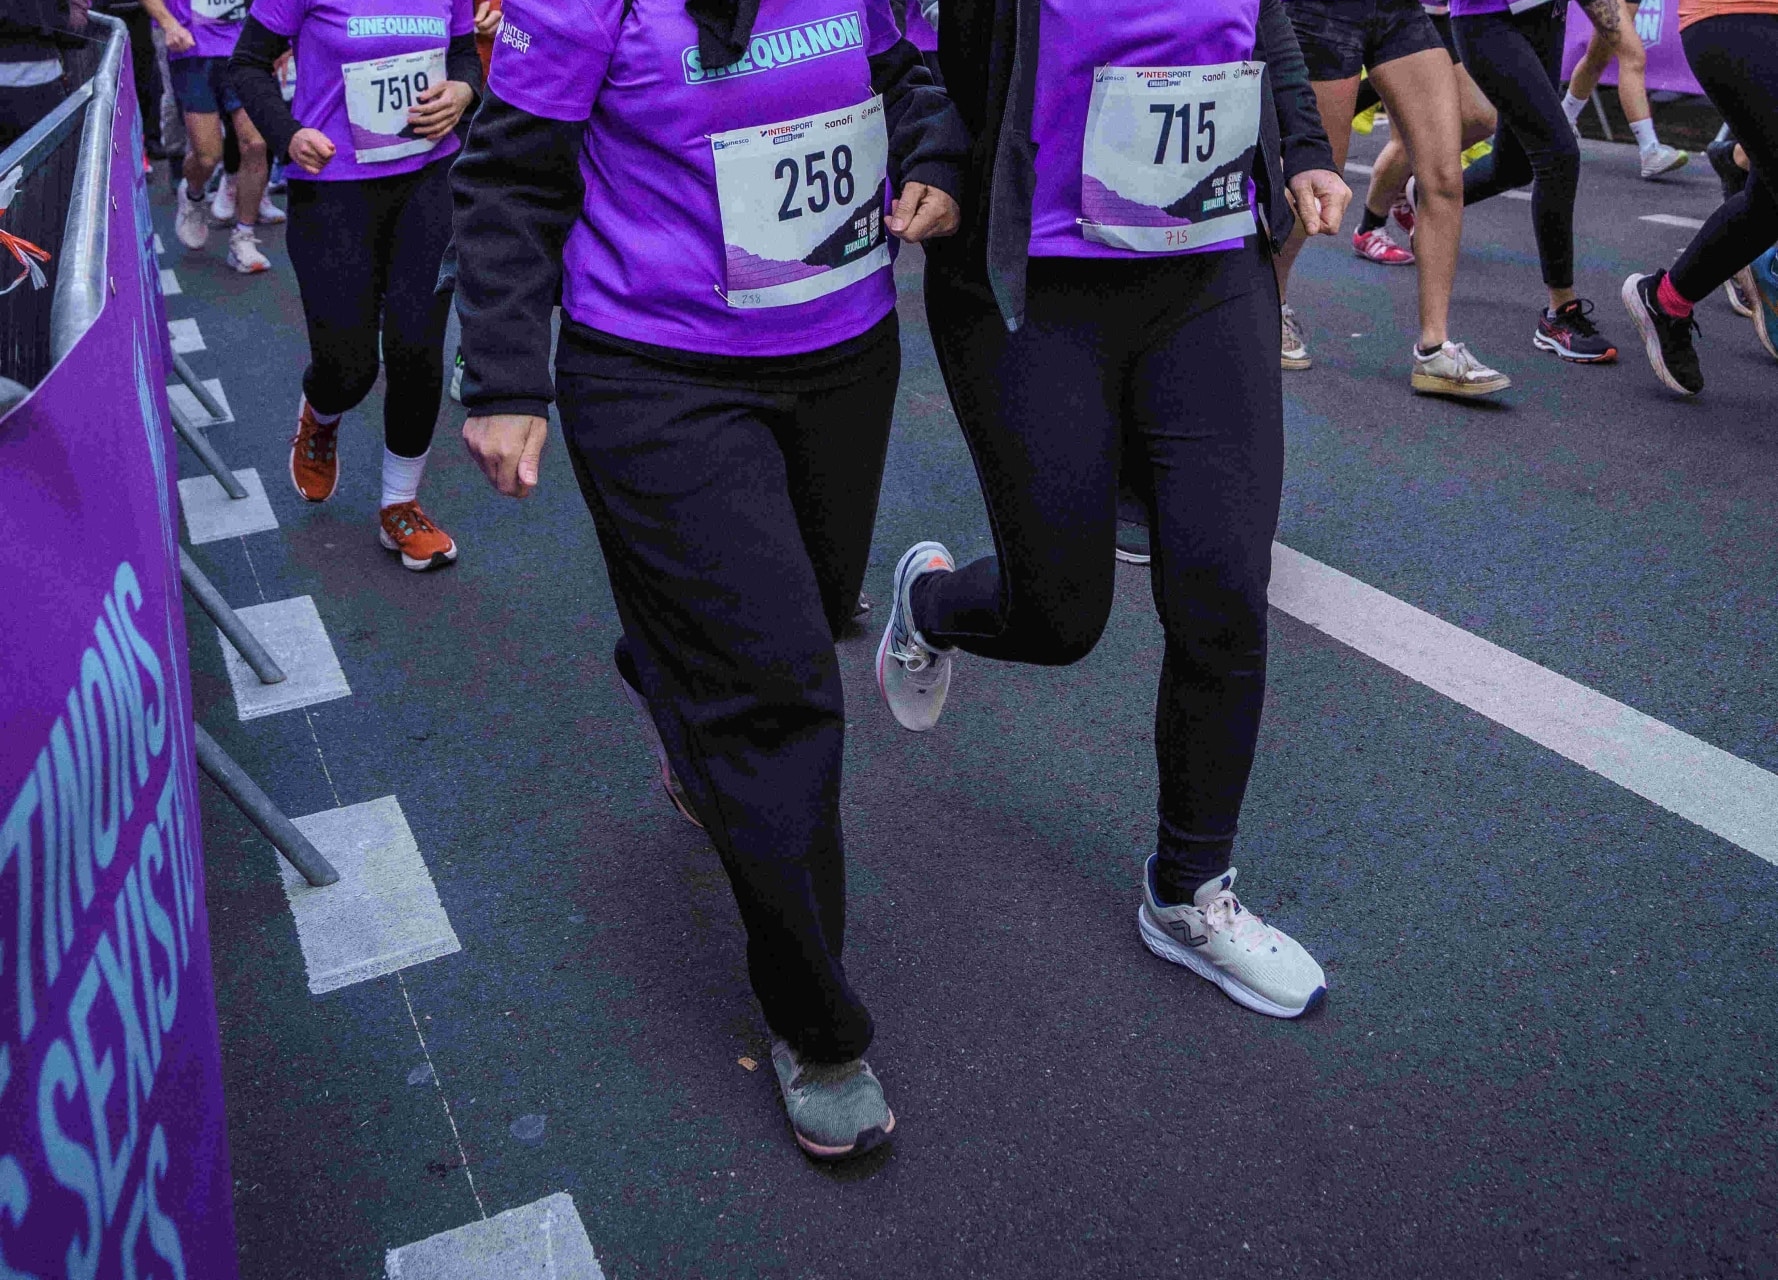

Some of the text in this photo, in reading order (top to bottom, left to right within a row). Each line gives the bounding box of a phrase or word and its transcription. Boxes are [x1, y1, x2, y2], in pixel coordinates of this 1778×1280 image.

[348, 16, 446, 37] SINEQUANON
[504, 21, 531, 44] INTER
[501, 31, 530, 54] SPORT
[1144, 70, 1191, 79] INTERSPORT
[1202, 71, 1226, 82] sanofi
[370, 71, 430, 113] 7519
[768, 121, 813, 136] INTERSPORT
[825, 115, 853, 129] sanofi
[1149, 100, 1216, 165] 715
[774, 144, 855, 223] 258
